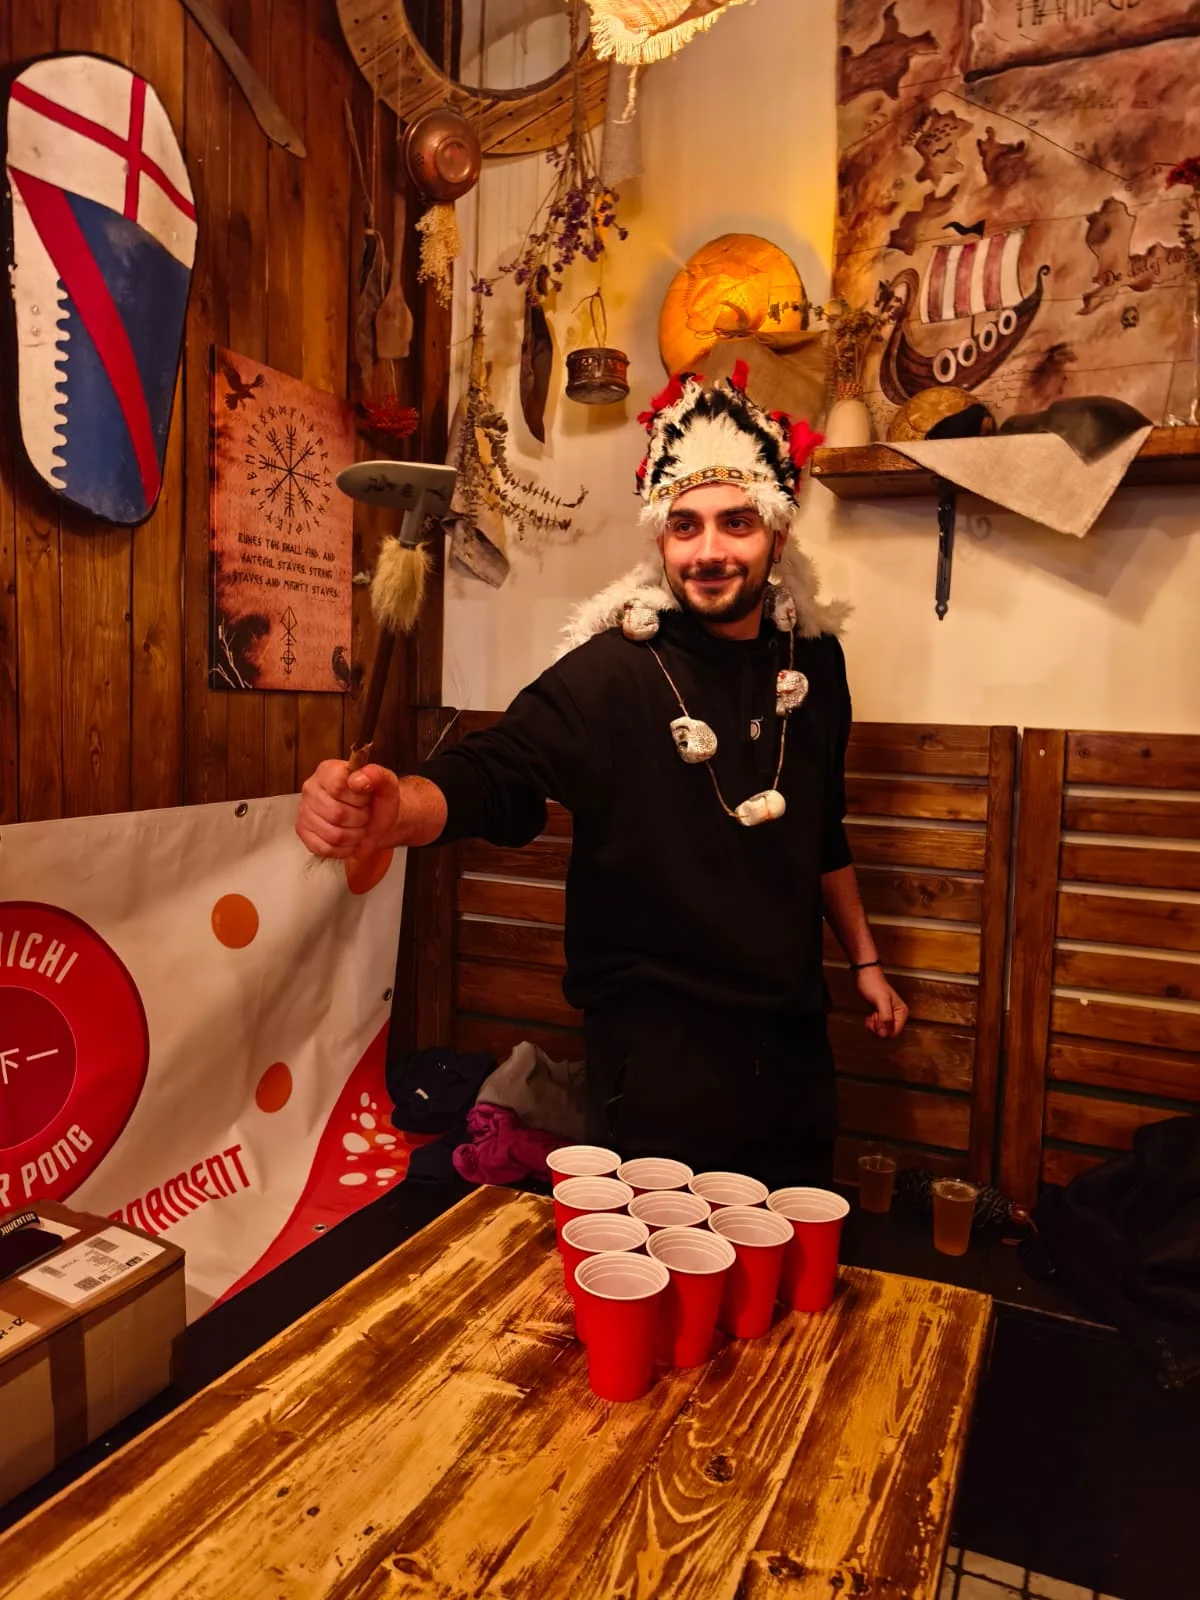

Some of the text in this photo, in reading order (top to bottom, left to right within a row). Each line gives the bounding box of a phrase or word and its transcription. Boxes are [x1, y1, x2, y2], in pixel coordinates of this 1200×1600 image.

[238, 532, 262, 546] RUNES
[281, 542, 302, 555] SHALL
[323, 552, 335, 562] AND
[231, 570, 263, 585] STAVES
[265, 577, 280, 588] AND
[283, 580, 309, 593] MIGHTY
[21, 1124, 94, 1198] PONG
[0, 1212, 36, 1237] JUVENTUS
